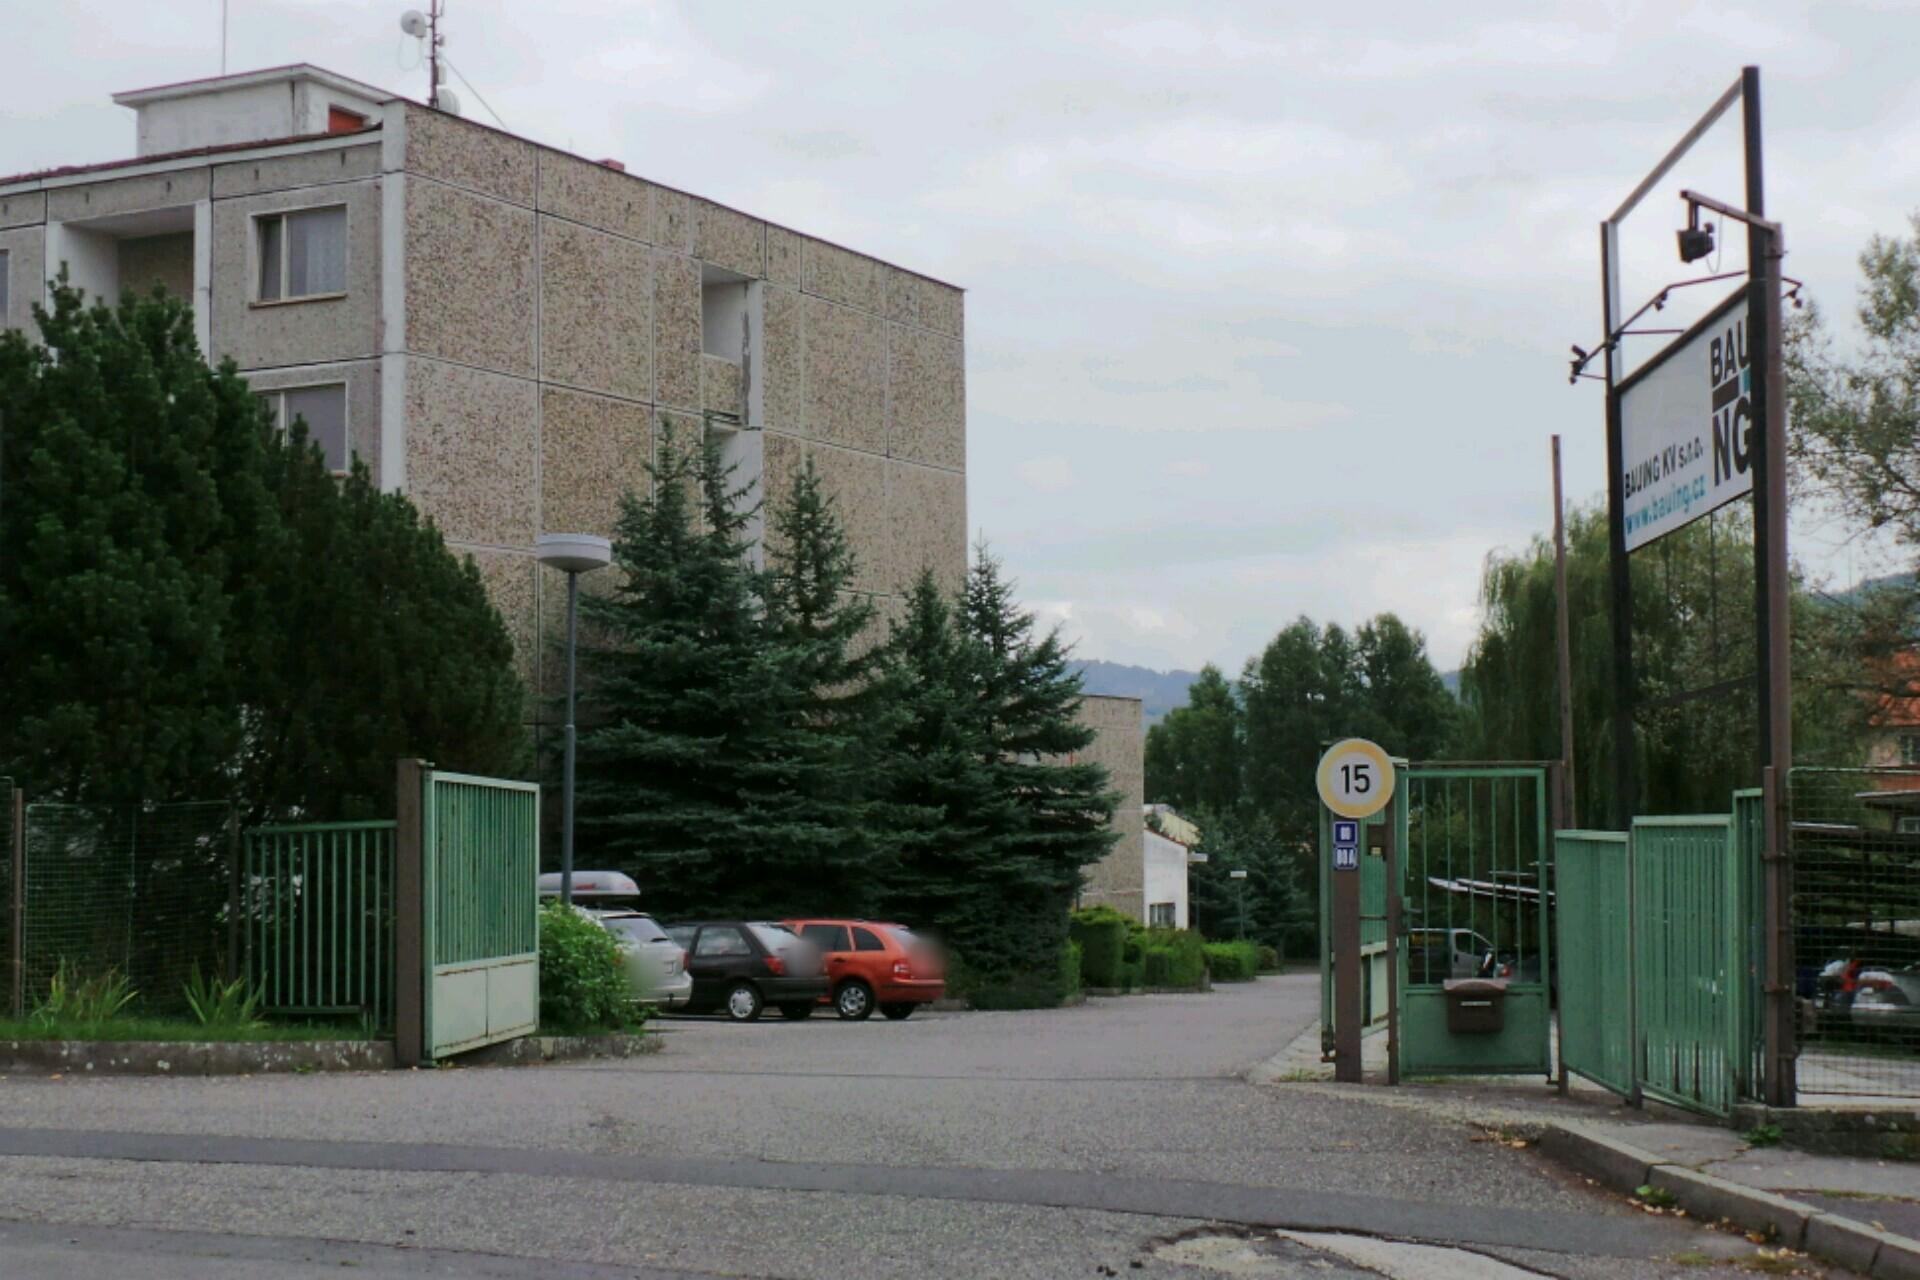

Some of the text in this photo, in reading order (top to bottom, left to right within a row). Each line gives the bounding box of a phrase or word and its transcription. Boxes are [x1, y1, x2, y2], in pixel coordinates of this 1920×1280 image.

[1710, 320, 1750, 388] BAU
[1662, 443, 1676, 479] KV
[1712, 396, 1751, 487] NG
[1625, 474, 1706, 535] www.bauing.cz
[1341, 764, 1370, 794] 15
